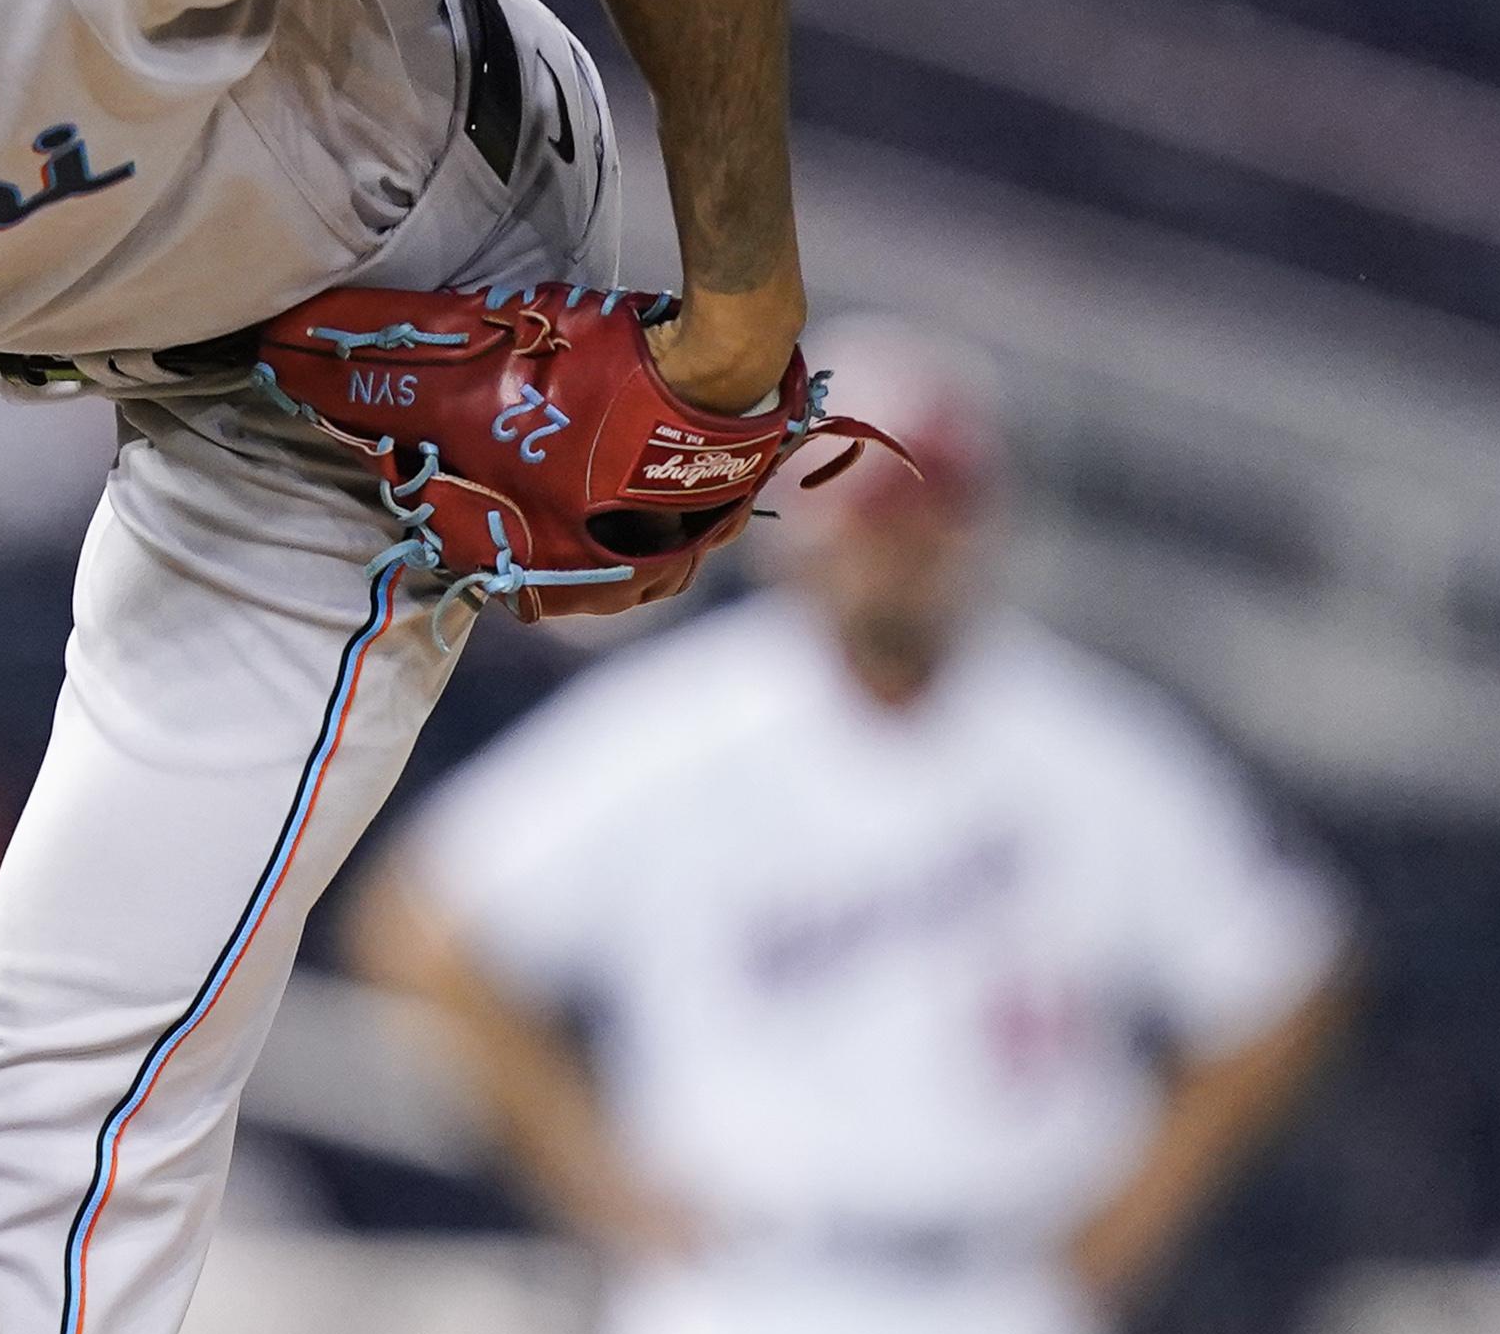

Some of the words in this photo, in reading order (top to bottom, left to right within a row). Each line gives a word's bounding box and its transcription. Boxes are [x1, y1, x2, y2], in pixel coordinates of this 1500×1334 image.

[348, 370, 418, 407] SYN
[490, 383, 571, 464] 22
[643, 451, 763, 488] Rawlings
